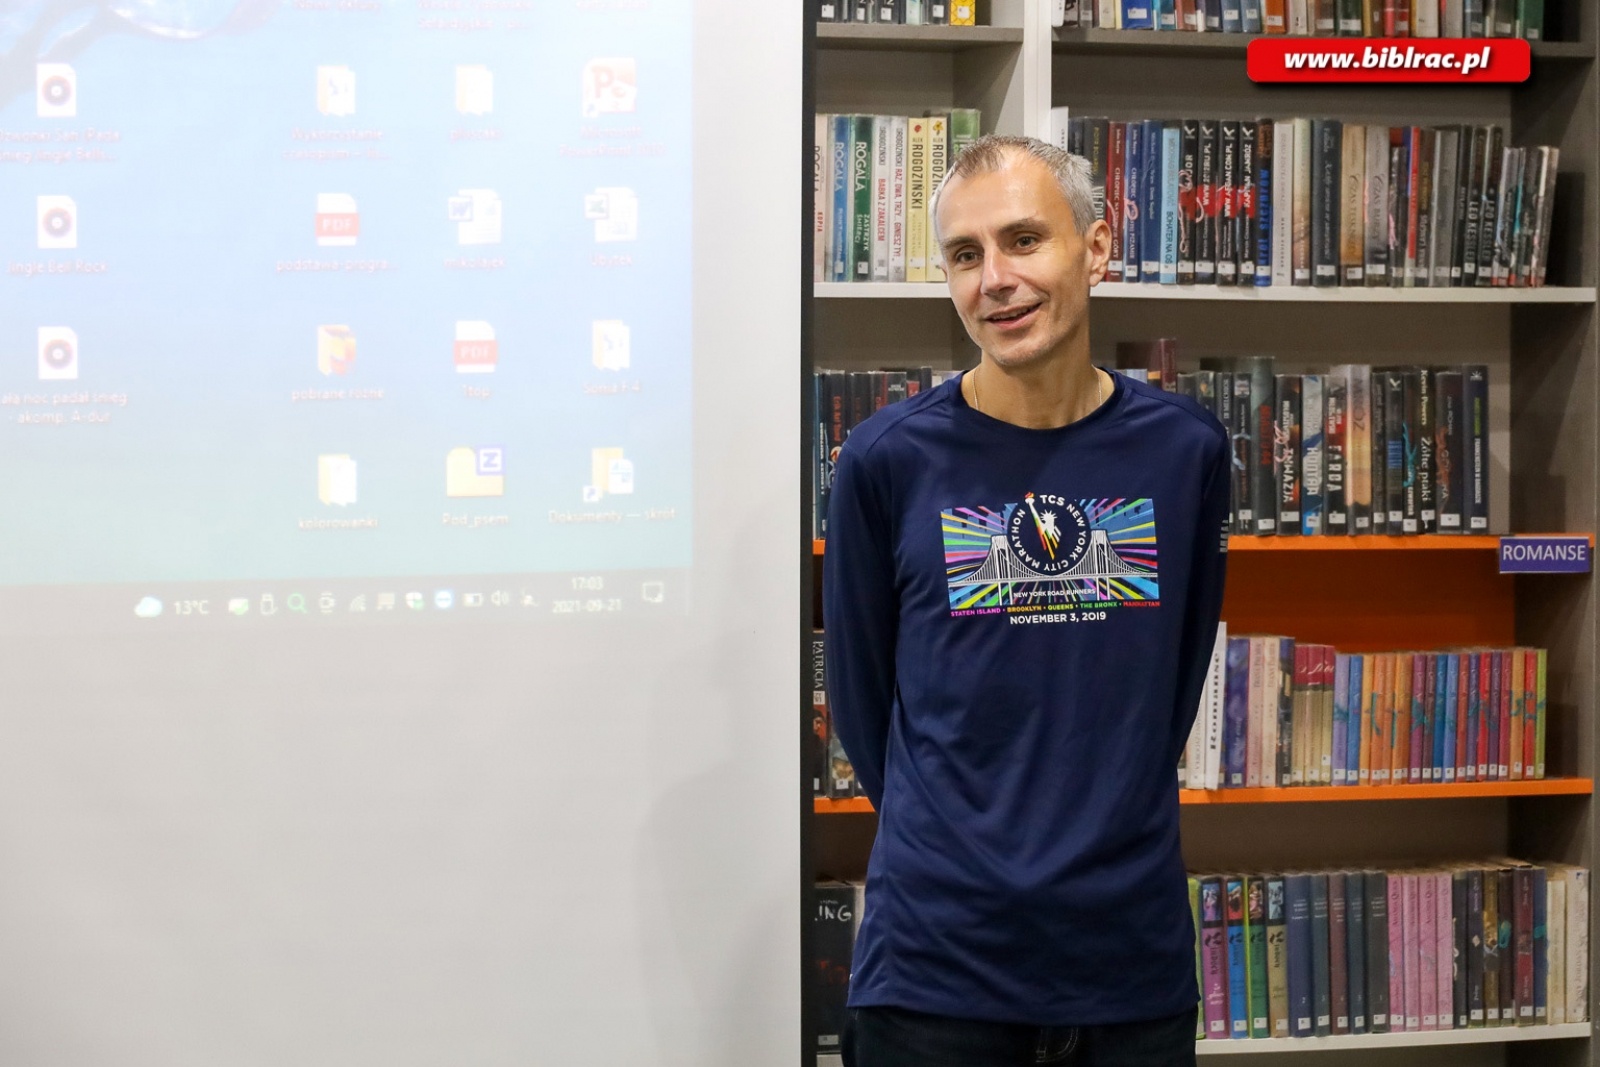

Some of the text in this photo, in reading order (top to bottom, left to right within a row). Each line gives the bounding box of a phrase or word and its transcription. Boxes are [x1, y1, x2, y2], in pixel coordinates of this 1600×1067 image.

[834, 141, 844, 191] ROGALA
[855, 141, 867, 191] ROGALA
[1243, 144, 1252, 174] JAMRÓZ
[911, 144, 925, 208] ROGOZIŃSKI
[878, 178, 886, 200] BABKA
[1244, 176, 1252, 208] KAPITAN
[1468, 201, 1477, 219] LEO
[322, 219, 352, 230] PDF
[878, 207, 886, 241] ZAKALCEM
[1165, 211, 1174, 242] BOHATER
[894, 222, 902, 246] GINIESZ
[1113, 239, 1121, 258] GÓRY
[1165, 243, 1173, 252] NA
[461, 345, 490, 359] PDF
[833, 396, 842, 410] Erik
[833, 411, 842, 422] Axl
[1419, 370, 1432, 502] Kevin Powers Żółte ptaki
[1282, 448, 1294, 502] INWAZJA
[298, 514, 378, 529] kolorowanki
[548, 508, 622, 524] Dokumenty
[1011, 494, 1086, 571] TCS NEW YORK CITY MARATHON
[1502, 544, 1586, 561] ROMANSE
[571, 575, 604, 590] 17:03
[1028, 590, 1046, 598] YORK
[1047, 589, 1065, 597] ROAD
[1066, 588, 1096, 596] RUNNERS
[552, 598, 622, 613] 2021-09-21
[951, 609, 975, 617] STATEN
[976, 608, 1001, 616] ISLAND
[1007, 605, 1042, 613] BROOKLYN
[1047, 603, 1074, 611] QUEENS
[1123, 600, 1160, 608] MANHATTAN
[1010, 611, 1106, 625] NOVEMBER 3, 2019
[815, 641, 824, 689] PATRICIA
[814, 904, 852, 922] ING
